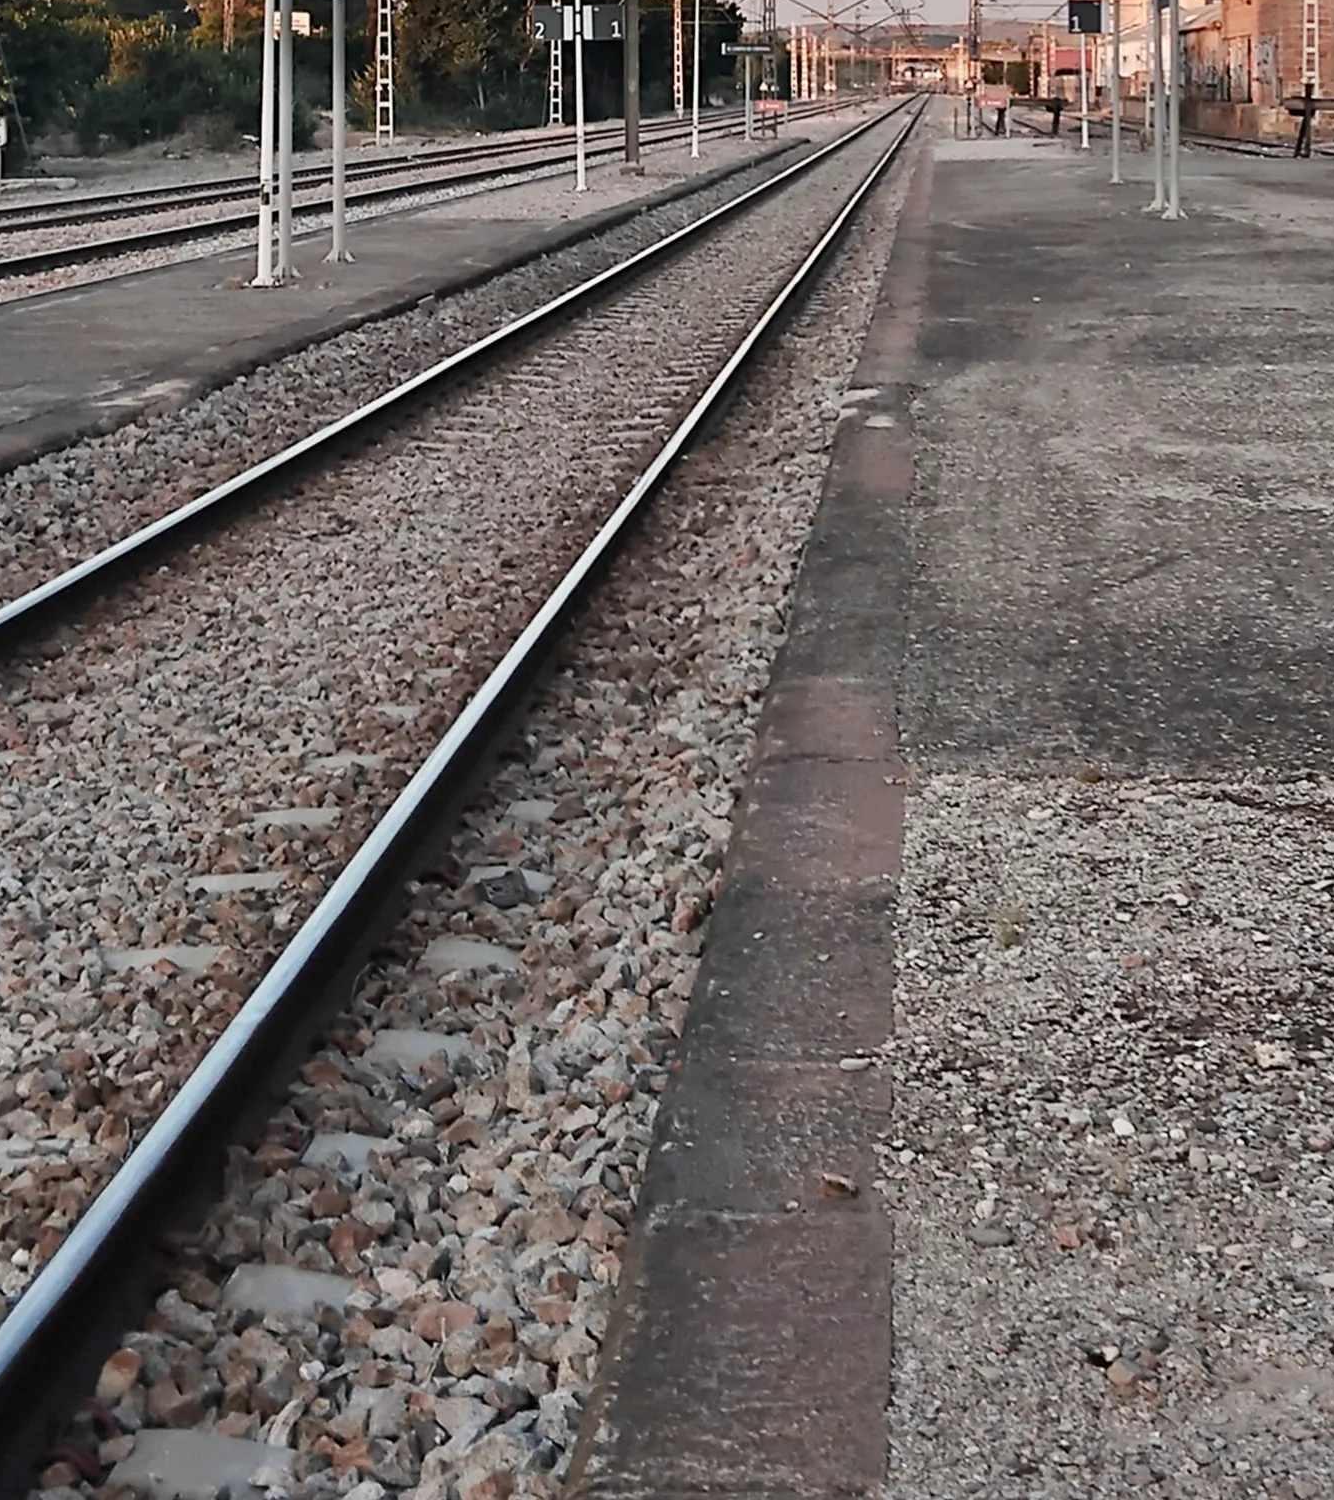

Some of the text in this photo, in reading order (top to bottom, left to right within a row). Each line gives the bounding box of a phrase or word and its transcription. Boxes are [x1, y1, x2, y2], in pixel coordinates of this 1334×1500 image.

[534, 21, 545, 40] 2
[611, 21, 622, 38] 1
[1070, 15, 1082, 32] 1
